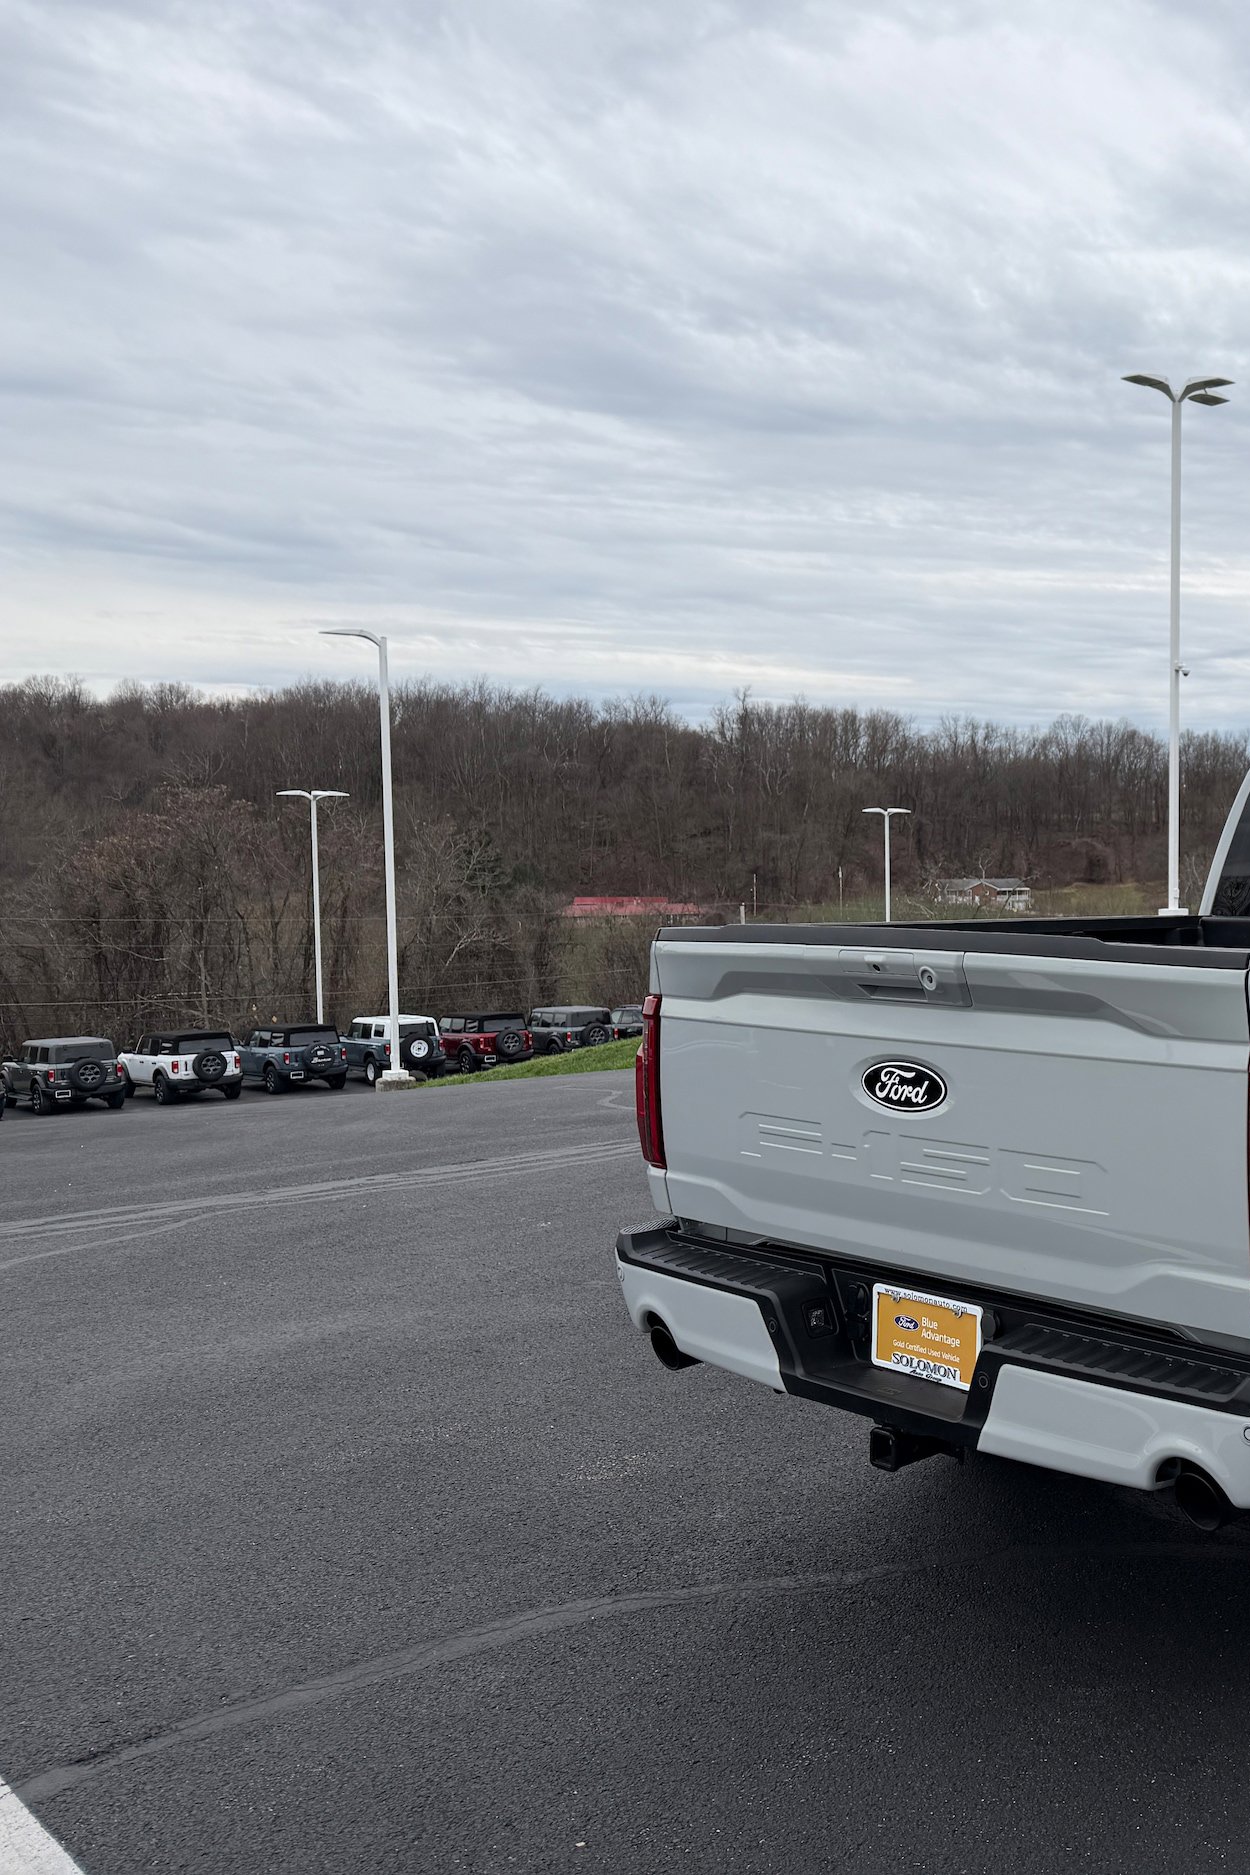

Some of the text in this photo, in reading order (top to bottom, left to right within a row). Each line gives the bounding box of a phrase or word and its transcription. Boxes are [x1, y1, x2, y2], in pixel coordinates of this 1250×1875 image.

[875, 1067, 930, 1104] Ford
[884, 1287, 968, 1313] www.solomonauto.com
[921, 1316, 938, 1330] Blue
[921, 1328, 960, 1348] Advantage
[892, 1339, 960, 1363] Gold Certified Used Vehicle
[892, 1352, 958, 1381] SOLOMON
[909, 1369, 924, 1377] Auto
